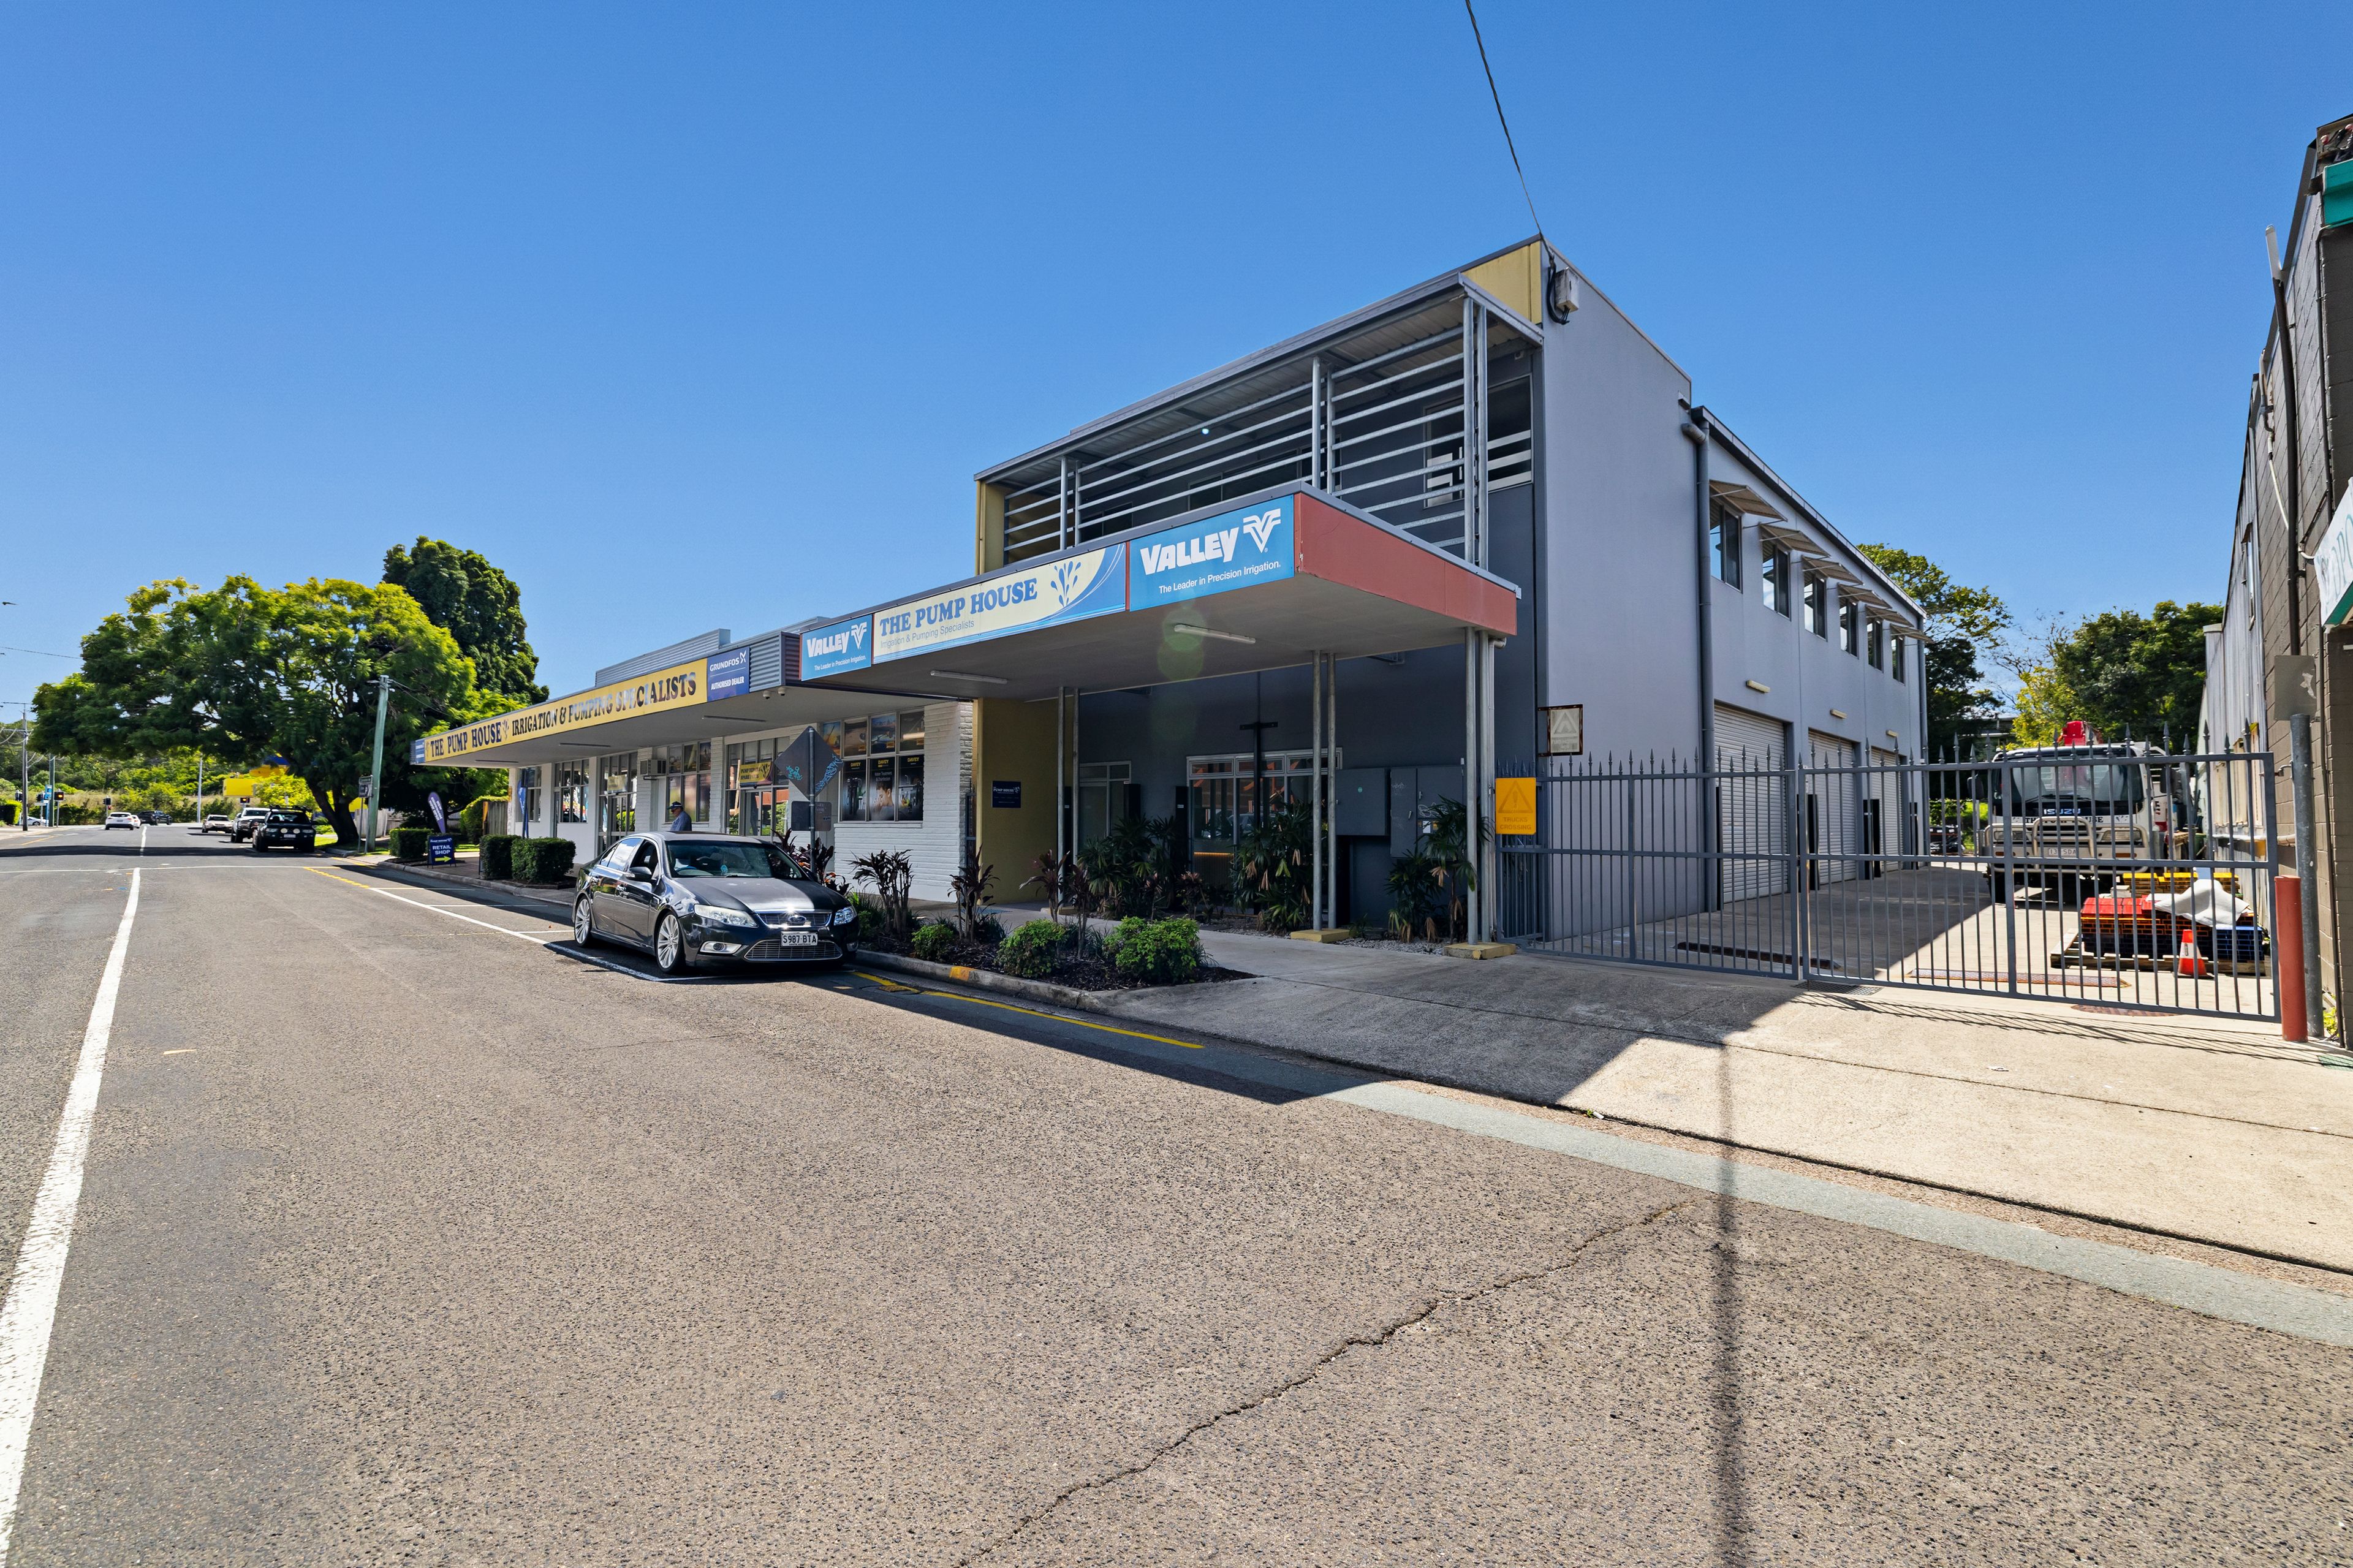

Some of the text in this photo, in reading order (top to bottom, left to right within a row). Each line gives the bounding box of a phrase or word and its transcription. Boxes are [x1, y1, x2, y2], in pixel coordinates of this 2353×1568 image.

[1140, 527, 1239, 575] VALLEY
[1159, 585, 1172, 594] The
[1173, 579, 1197, 591] Leader
[1199, 577, 1205, 585] in
[1208, 569, 1241, 583] Precision
[880, 578, 1037, 636] THE PUMP HOUSE
[807, 631, 850, 657] VALLEY
[881, 635, 904, 648] Irrigation
[912, 628, 939, 642] Pumping
[940, 619, 974, 635] Specialists
[710, 657, 740, 672] GRUNDFOS
[711, 676, 745, 691] AUTHORISED DEALER
[431, 672, 696, 757] THE PUMP HOUSE IRRIGATION & PUMPING SPECIALISTS
